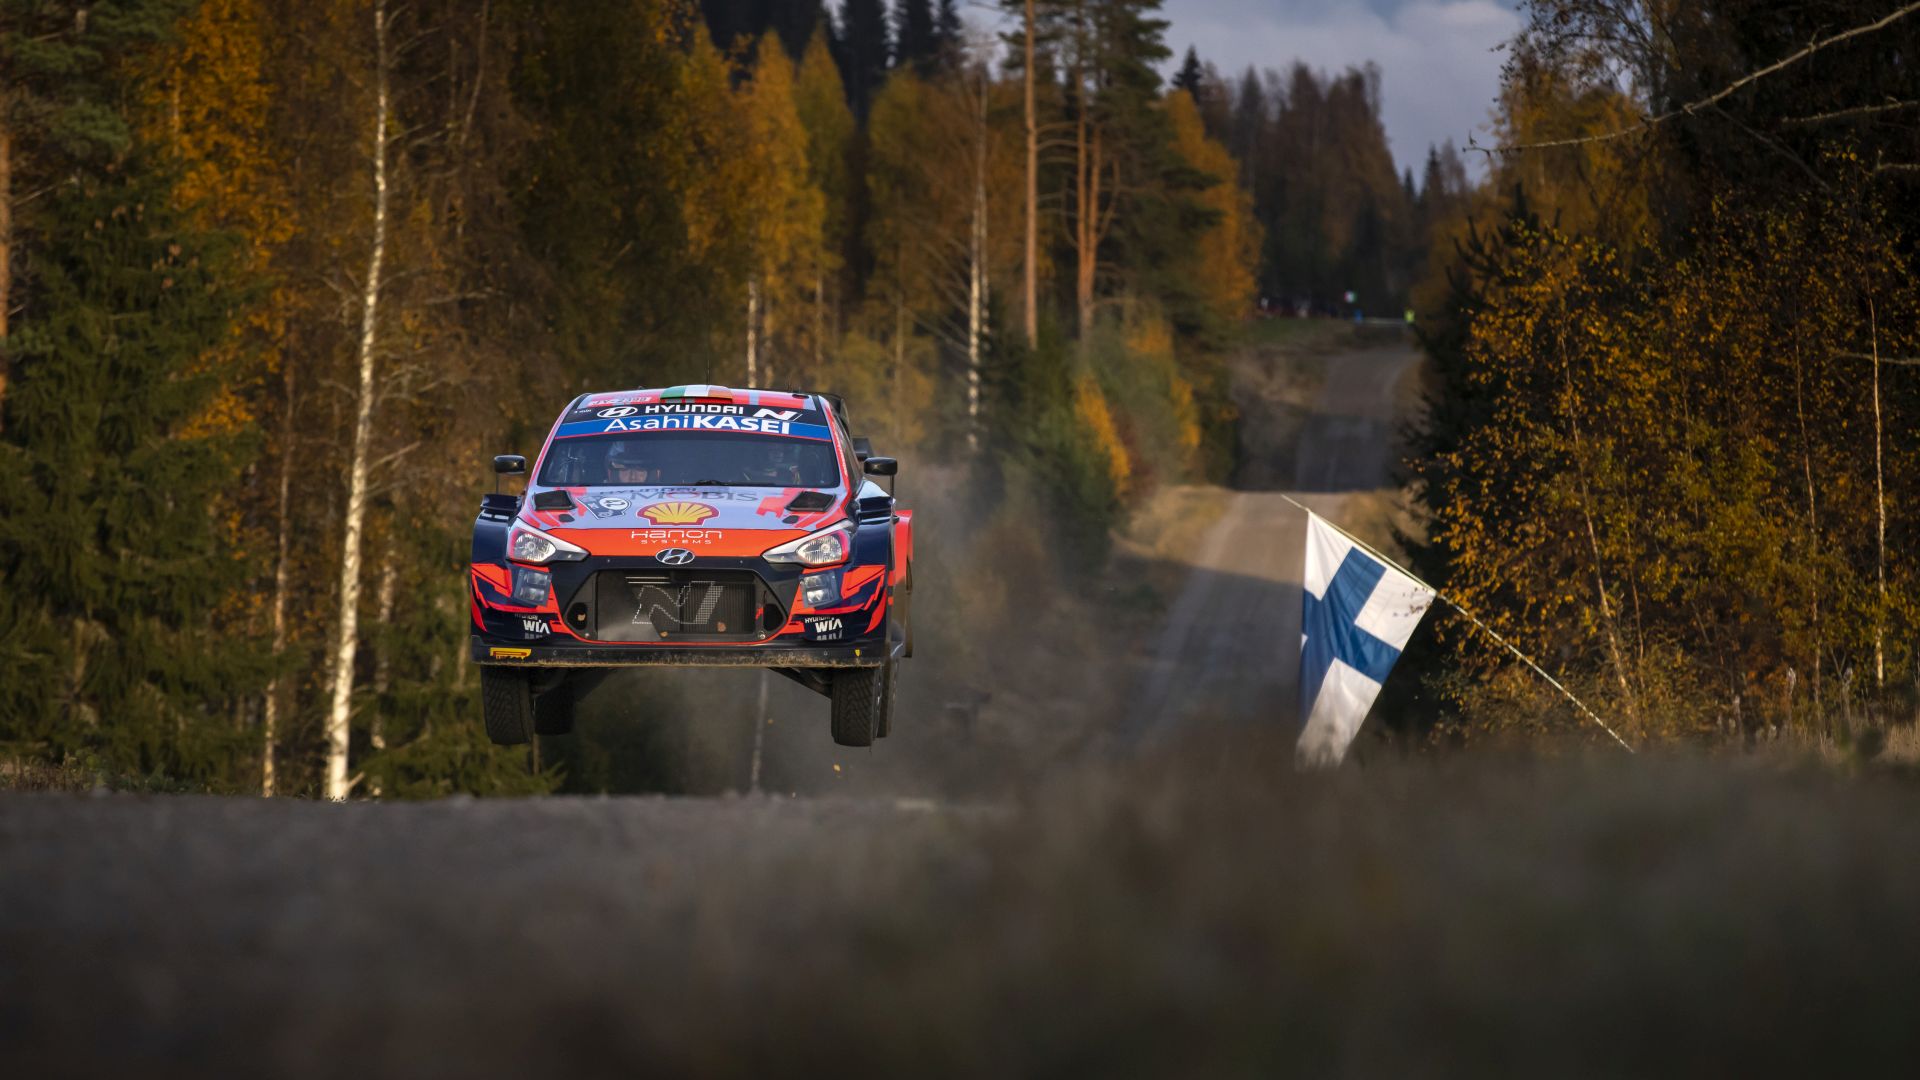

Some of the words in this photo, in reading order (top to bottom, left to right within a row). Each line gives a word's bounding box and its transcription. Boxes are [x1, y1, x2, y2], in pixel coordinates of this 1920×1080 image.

[644, 404, 744, 415] HYUNDAI
[631, 490, 758, 501] MOBIS
[523, 619, 550, 635] WIA
[815, 617, 843, 633] WIA
